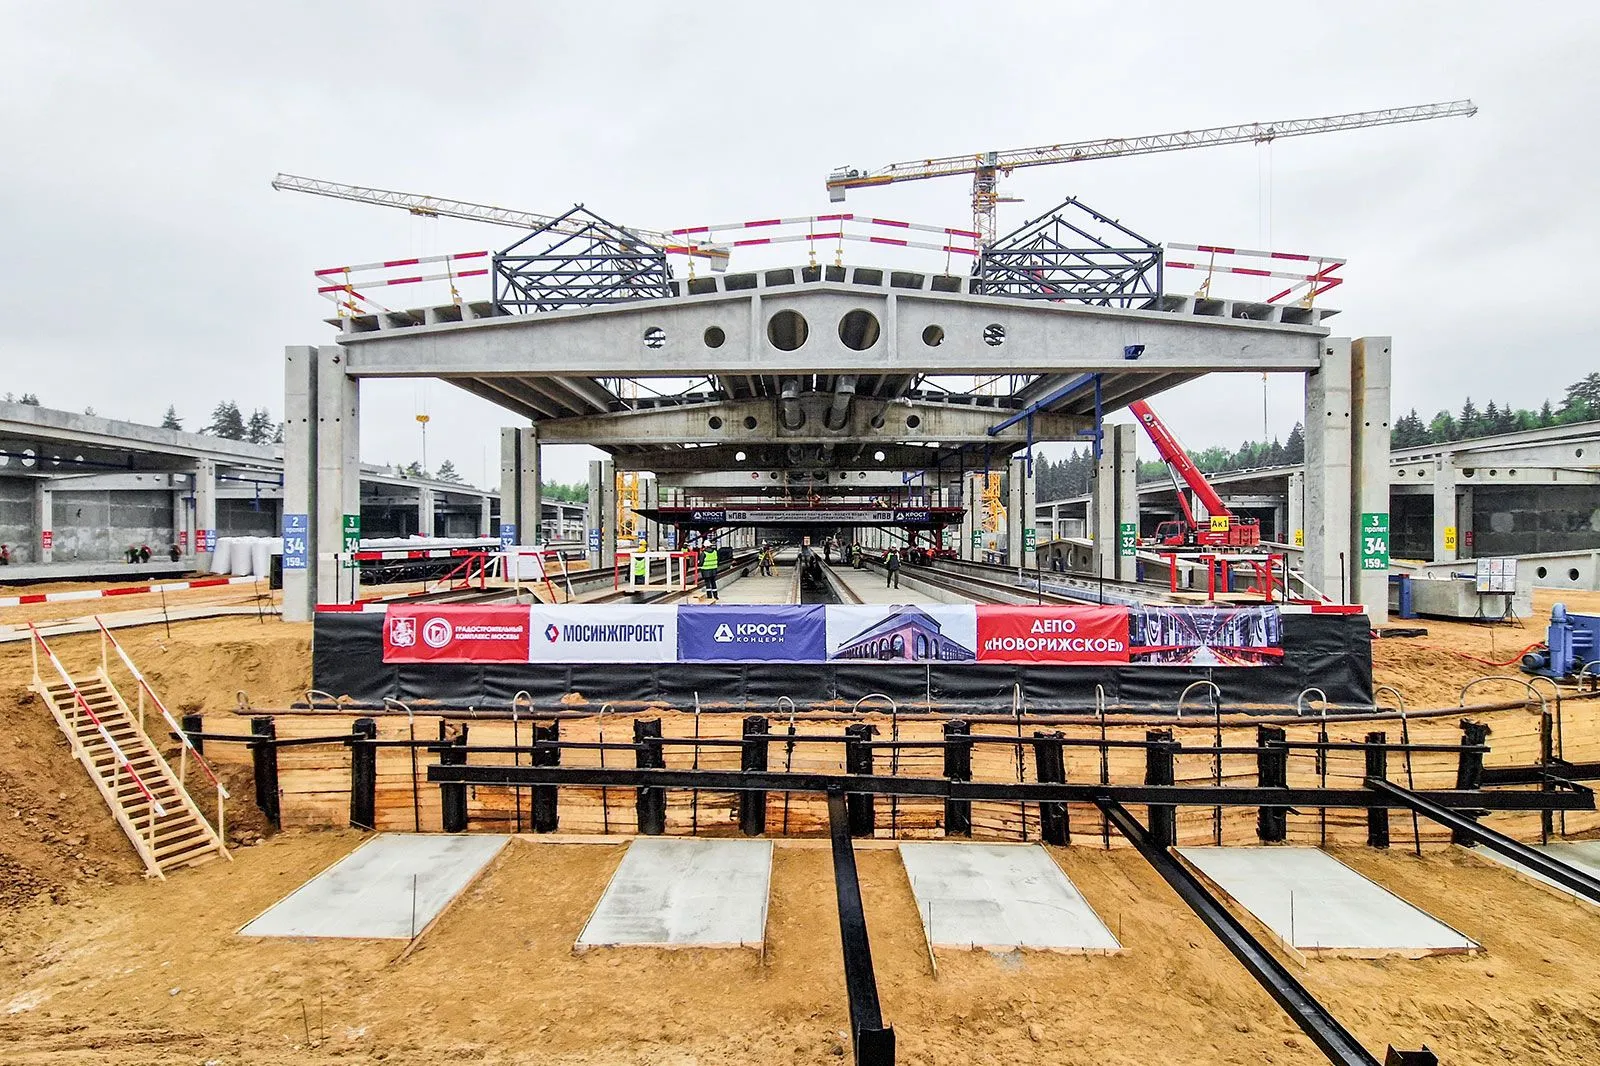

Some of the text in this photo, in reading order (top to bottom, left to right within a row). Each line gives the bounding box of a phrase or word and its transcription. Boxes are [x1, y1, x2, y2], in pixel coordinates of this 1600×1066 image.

[292, 516, 299, 527] 2
[349, 517, 355, 527] 3
[1372, 515, 1379, 526] 3
[285, 537, 305, 554] 34
[1025, 538, 1035, 546] 30
[1122, 537, 1135, 548] 32
[1364, 537, 1387, 555] 34
[736, 624, 787, 635] КРОСТ
[1030, 619, 1076, 634] ДЕПО
[563, 624, 664, 642] МОСИНЖПРОЕКТ
[984, 637, 1124, 652] «НОВОРИЖСКОЕ»
